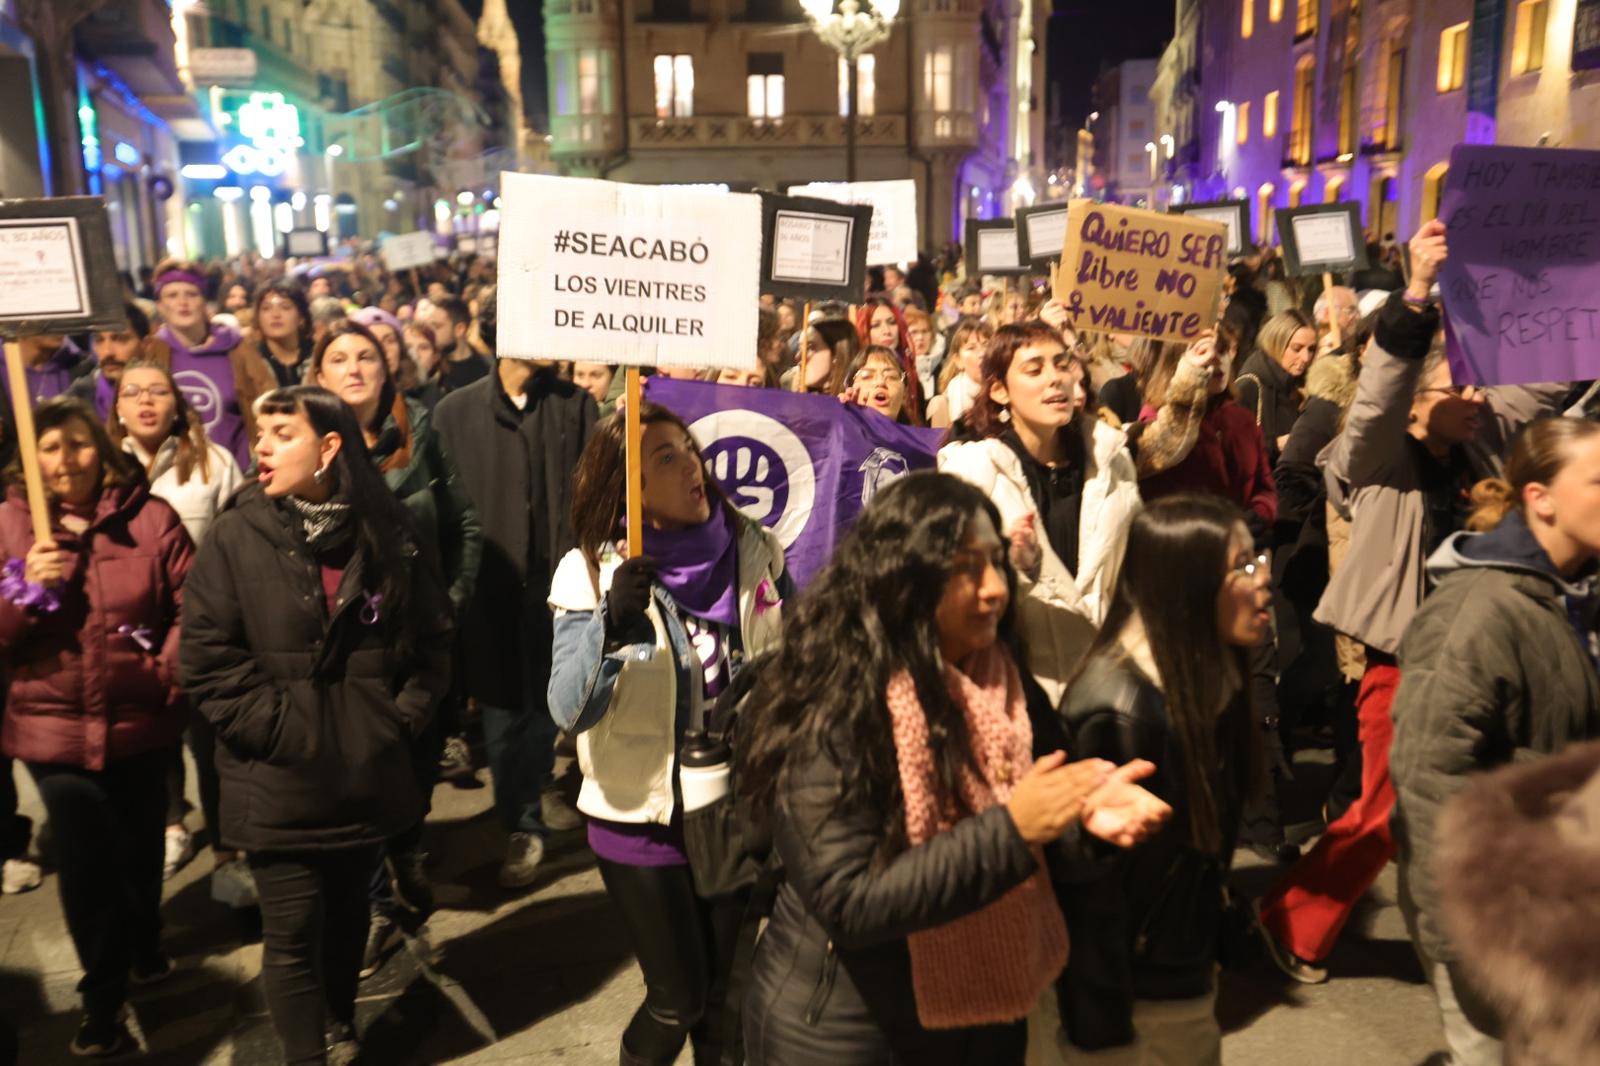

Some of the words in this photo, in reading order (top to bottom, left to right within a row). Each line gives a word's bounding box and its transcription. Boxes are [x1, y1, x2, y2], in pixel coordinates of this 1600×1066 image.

[1463, 160, 1516, 189] HOY
[1447, 204, 1478, 231] ES
[1482, 202, 1511, 229] EL
[1554, 200, 1598, 225] DEL
[554, 229, 709, 265] #SEACABÓ
[1178, 233, 1224, 269] SER
[1500, 230, 1593, 259] HOMBRE
[554, 274, 597, 295] LOS
[604, 277, 706, 302] VIENTRES
[1155, 268, 1197, 299] NO
[554, 309, 585, 328] DE
[592, 312, 704, 337] ALQUILER
